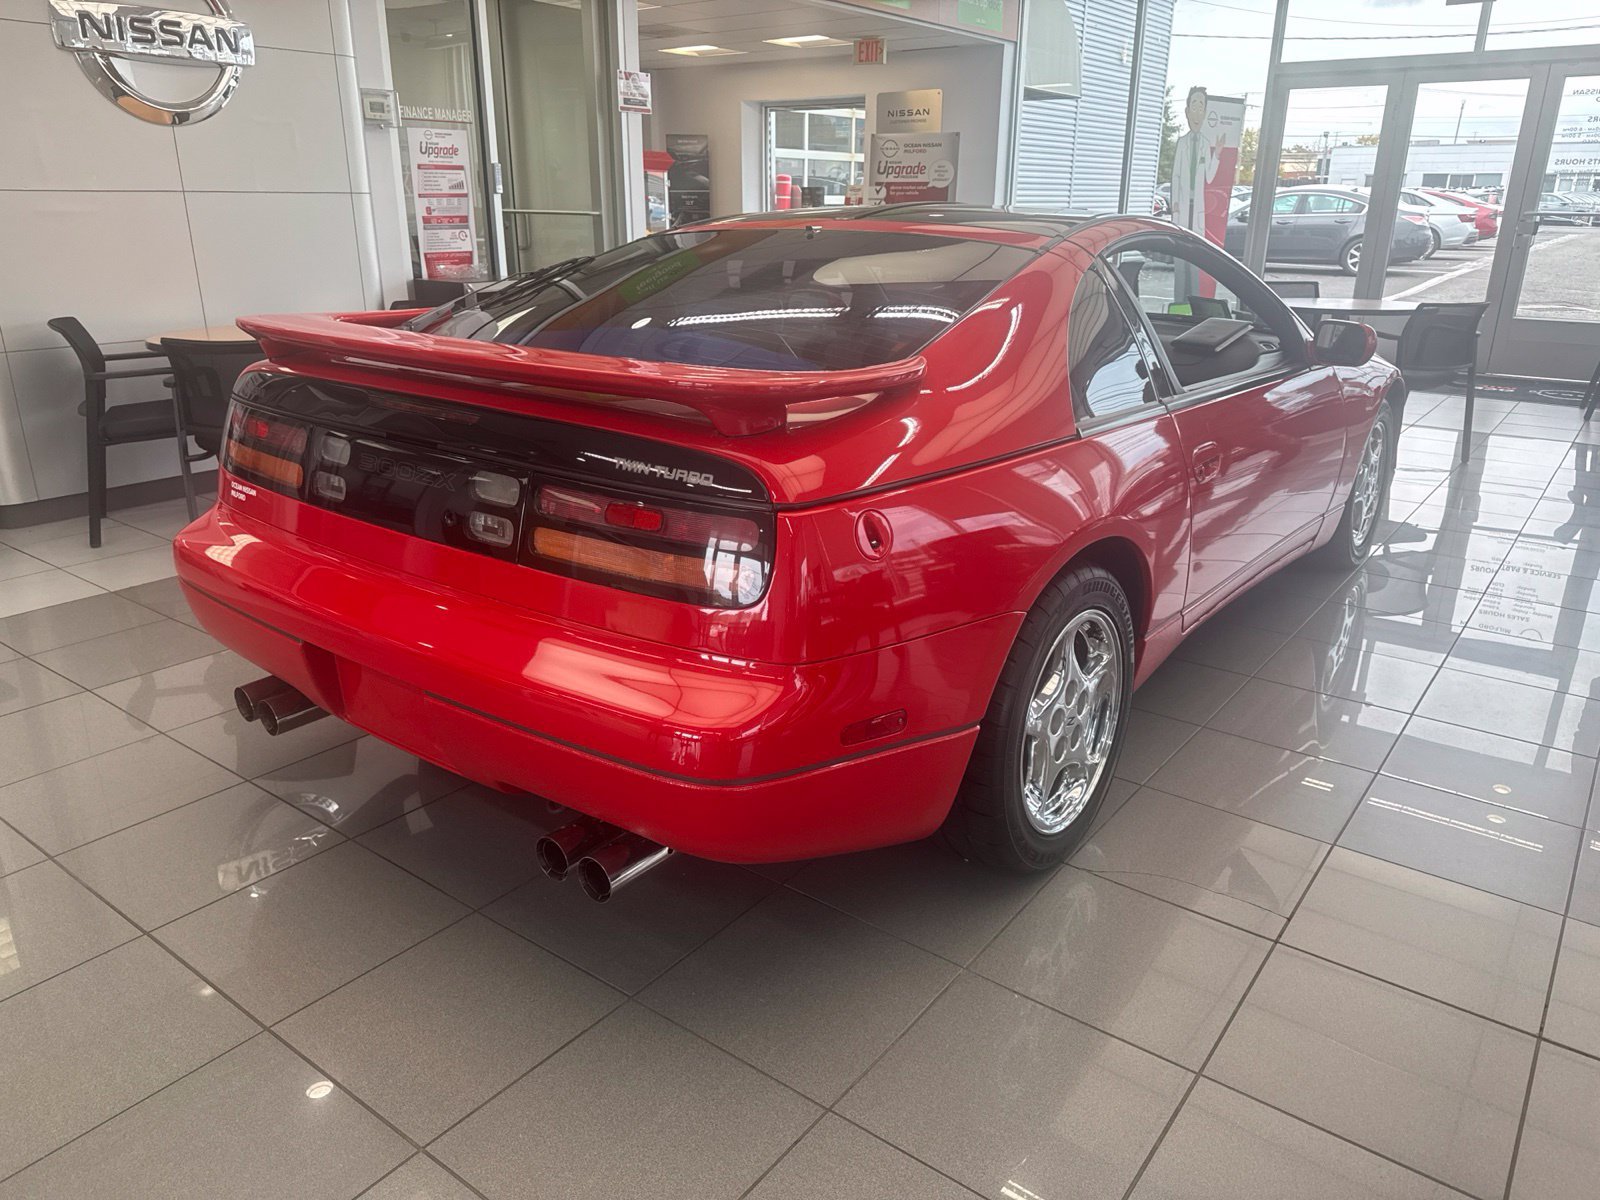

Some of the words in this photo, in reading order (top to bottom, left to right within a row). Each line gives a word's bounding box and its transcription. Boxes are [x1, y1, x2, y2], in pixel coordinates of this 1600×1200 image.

[76, 11, 241, 54] NISSAN
[859, 40, 880, 62] EXIT
[400, 105, 433, 119] FINANCE
[434, 108, 473, 122] MANAGER
[887, 108, 930, 117] NISSAN
[419, 141, 459, 158] Upgrade
[877, 160, 926, 178] Upgrade
[358, 453, 457, 491] 300ZX
[614, 456, 651, 475] TWIN
[654, 465, 714, 486] TURBO
[231, 481, 243, 491] OCEAN
[242, 485, 257, 497] NISSAN
[231, 489, 246, 501] MILFORD
[1530, 568, 1561, 580] SERVICE
[1478, 609, 1506, 619] HOURS
[1506, 613, 1531, 623] SALES
[1478, 623, 1512, 634] MILFORD
[1066, 716, 1075, 726] Z
